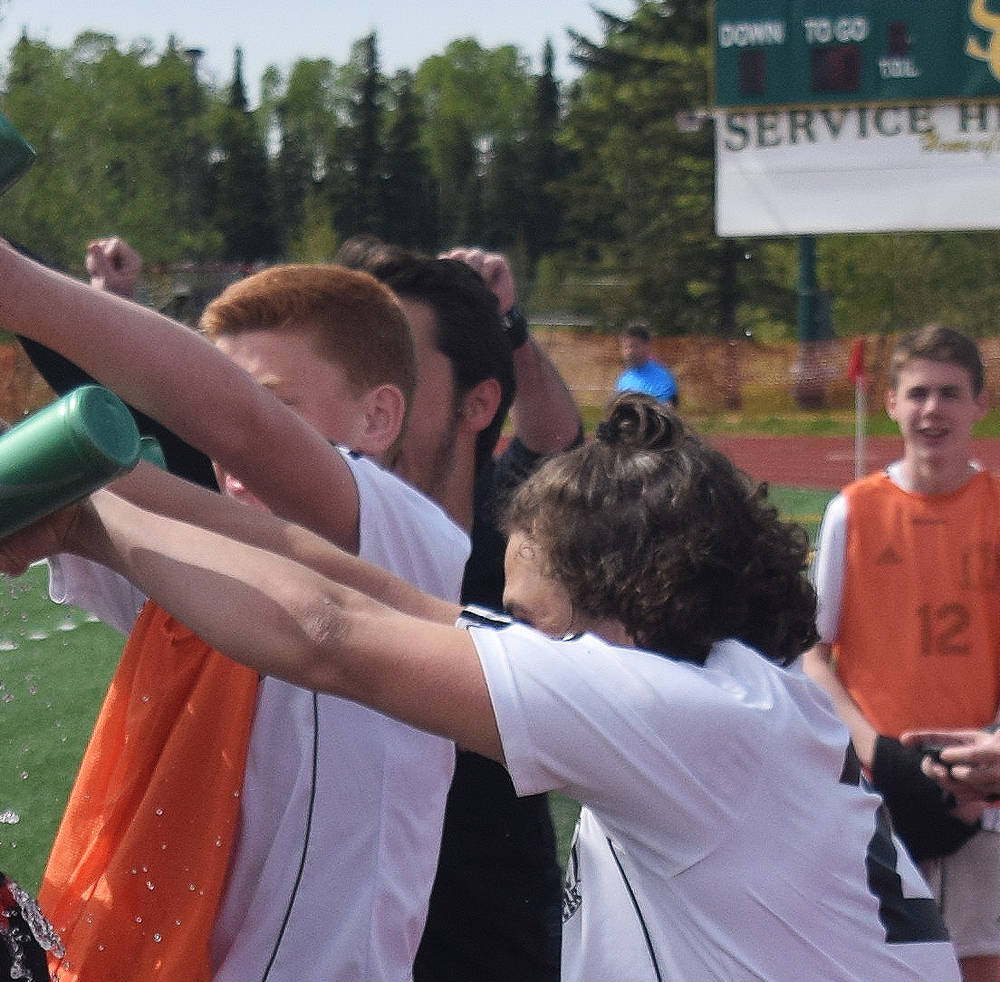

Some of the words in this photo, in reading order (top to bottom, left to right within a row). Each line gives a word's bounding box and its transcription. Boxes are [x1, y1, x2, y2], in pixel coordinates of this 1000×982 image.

[719, 22, 785, 47] DOWN
[804, 17, 832, 44] TO
[836, 15, 869, 42] GO
[725, 107, 931, 150] SERVICE
[917, 602, 972, 657] 12
